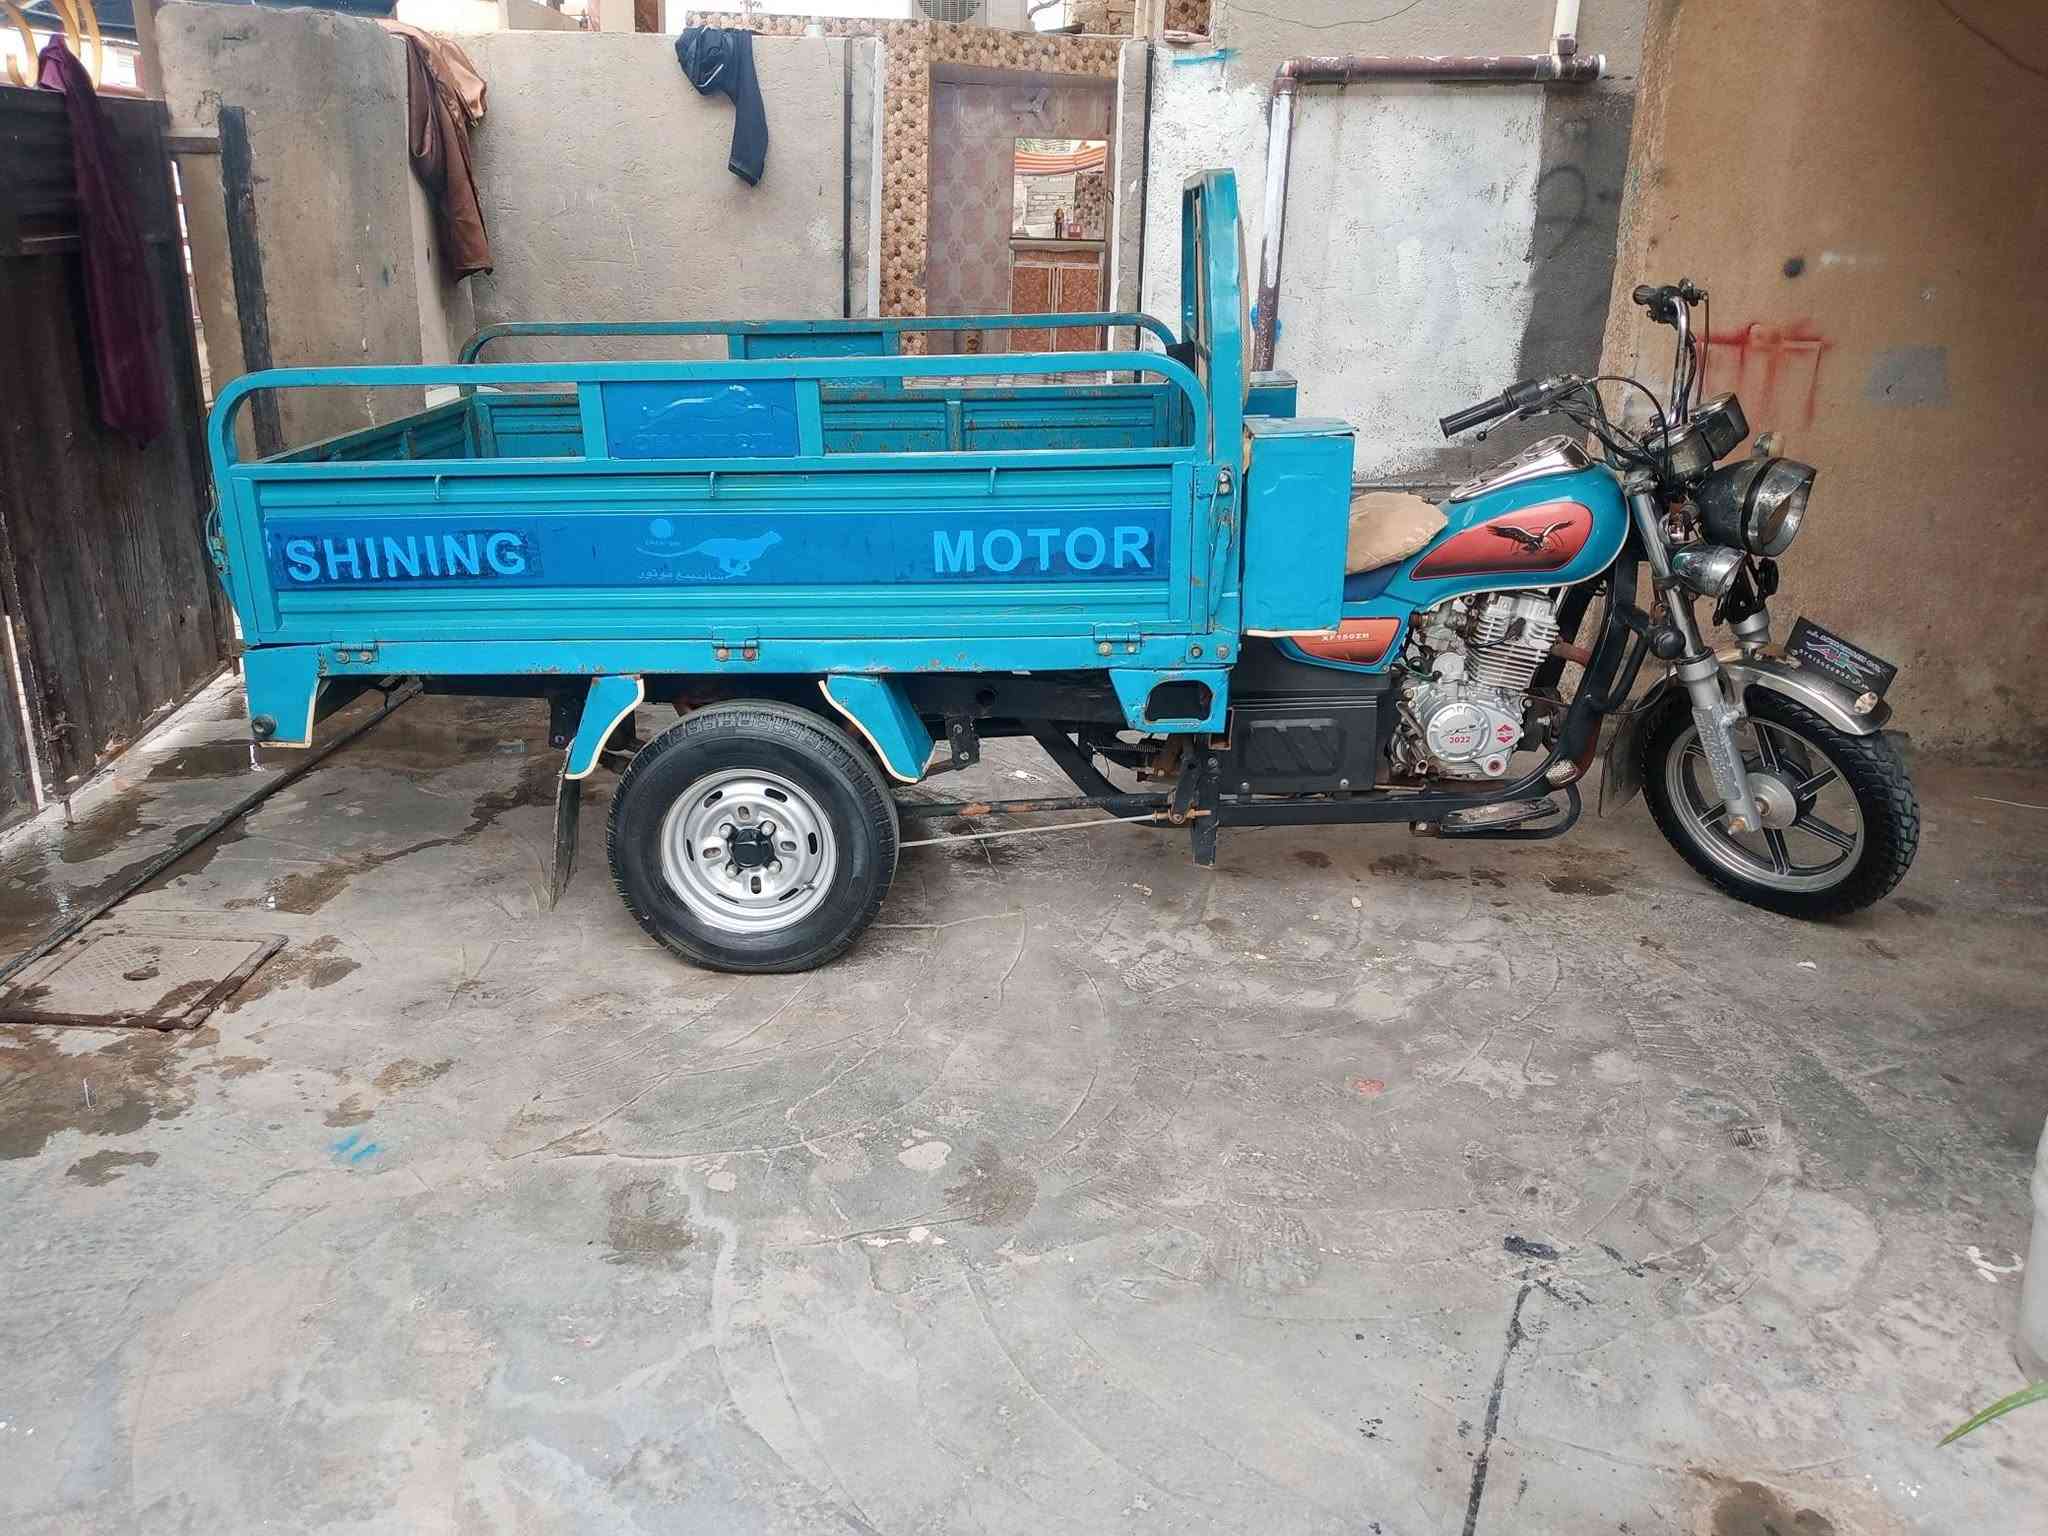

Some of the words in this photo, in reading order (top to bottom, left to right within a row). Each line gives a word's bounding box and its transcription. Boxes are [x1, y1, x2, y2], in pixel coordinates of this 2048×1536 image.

[286, 532, 525, 582] SHINING
[933, 526, 1152, 573] MOTOR
[1449, 736, 1471, 744] 2022
